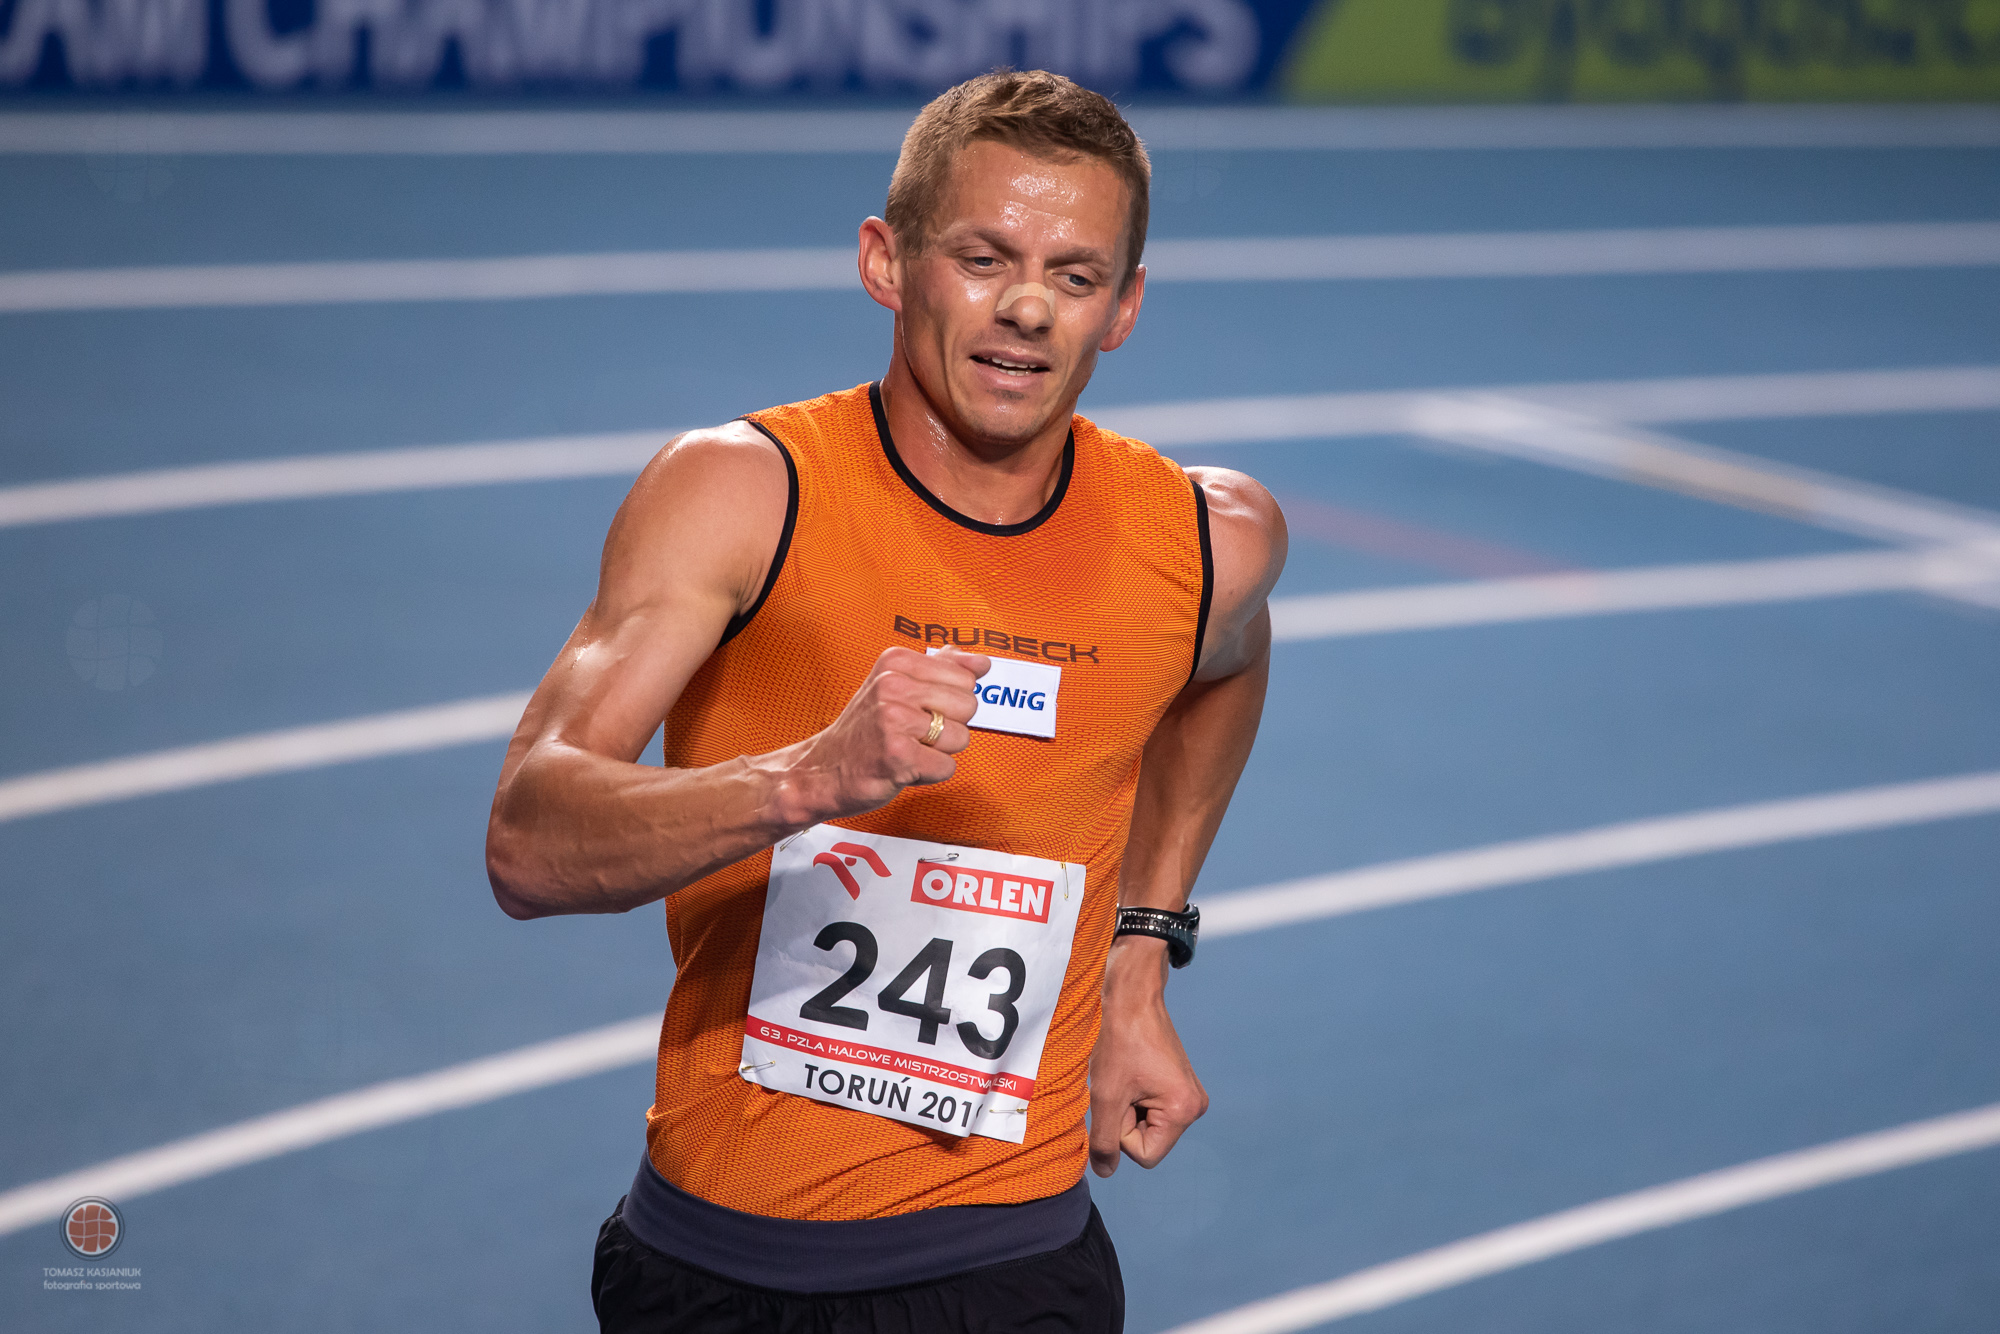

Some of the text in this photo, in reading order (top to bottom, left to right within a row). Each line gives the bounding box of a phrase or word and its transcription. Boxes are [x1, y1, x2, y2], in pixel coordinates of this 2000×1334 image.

[893, 615, 1100, 664] BRUBECK
[921, 869, 1046, 917] ORLEN
[799, 921, 1026, 1060] 243
[760, 1026, 783, 1041] 63.
[787, 1034, 825, 1053] PZLA
[828, 1044, 891, 1065] HALOWE
[805, 1063, 984, 1128] TORUŃ 201
